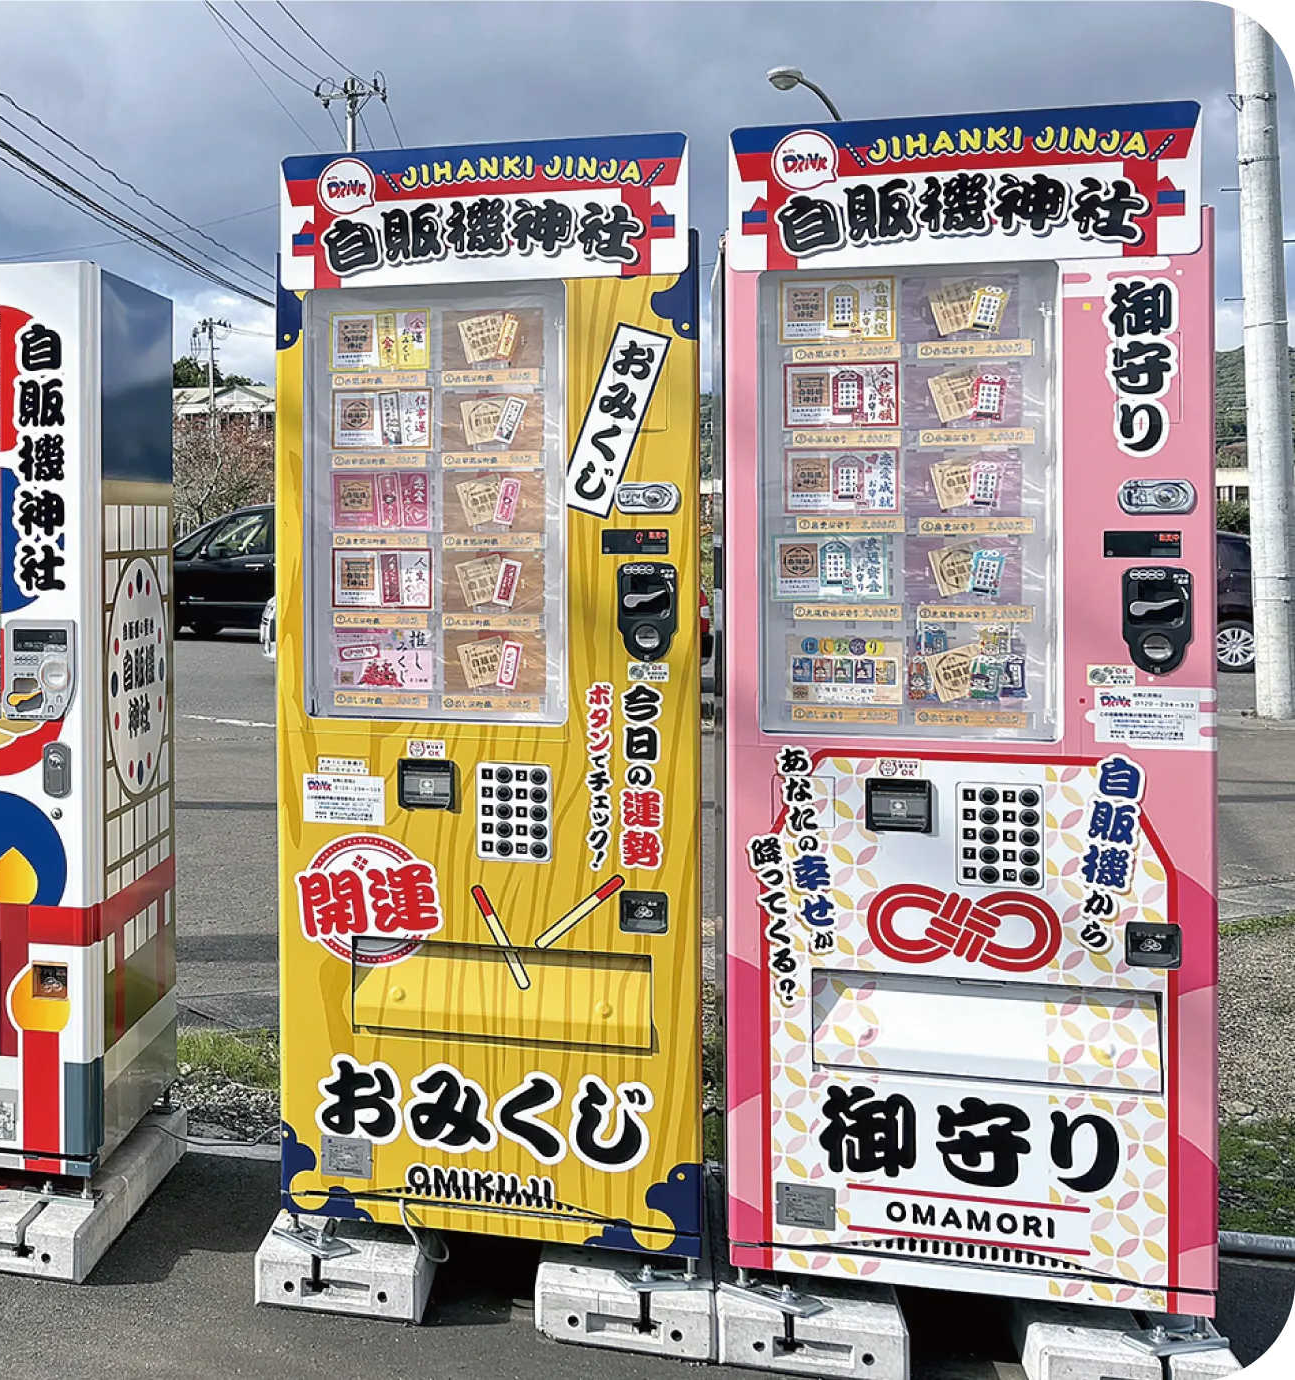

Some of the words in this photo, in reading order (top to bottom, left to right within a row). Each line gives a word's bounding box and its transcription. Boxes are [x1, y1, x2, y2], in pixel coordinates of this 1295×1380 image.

[400, 154, 535, 190] JIHANKI
[544, 153, 643, 188] JINJA
[867, 125, 1023, 163] JIHANKI
[1034, 125, 1150, 158] JINJA
[325, 198, 645, 270] 自販機神社
[778, 172, 1151, 253] 自販機神社
[575, 340, 654, 501] おみくじ
[1109, 281, 1173, 452] 御守り
[18, 323, 67, 593] 自販機神社
[588, 684, 612, 868] ボタンでチェック!
[623, 685, 662, 868] 今日の運勢
[299, 864, 439, 938] 開運
[780, 748, 835, 950] あなたの幸せが
[1079, 758, 1141, 951] 自販機から
[750, 836, 798, 1002] 降ってくる?
[321, 1060, 646, 1164] おみくじ
[819, 1085, 1120, 1193] 御守り
[407, 1165, 553, 1202] OMIKUJI
[886, 1201, 1056, 1239] OMAMORI
